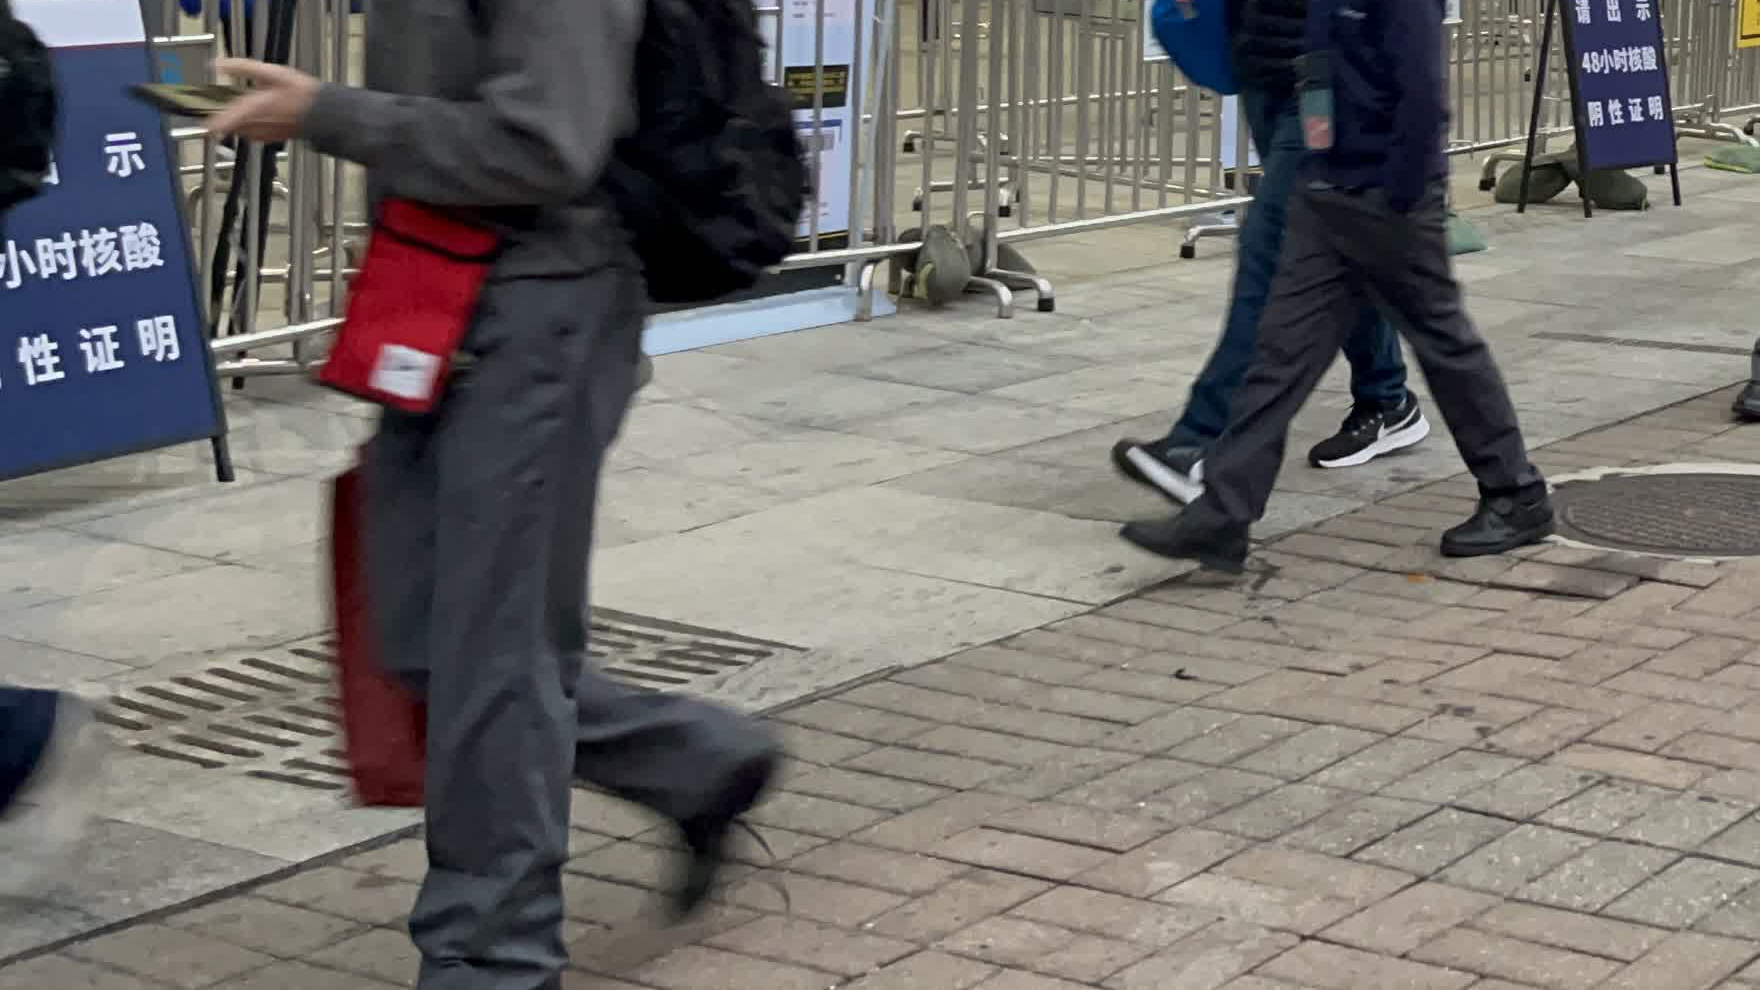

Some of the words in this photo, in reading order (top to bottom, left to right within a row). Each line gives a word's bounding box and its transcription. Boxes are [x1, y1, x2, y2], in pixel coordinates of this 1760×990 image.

[1581, 46, 1658, 74] 48小时核酸
[1587, 96, 1664, 128] 阴性证明
